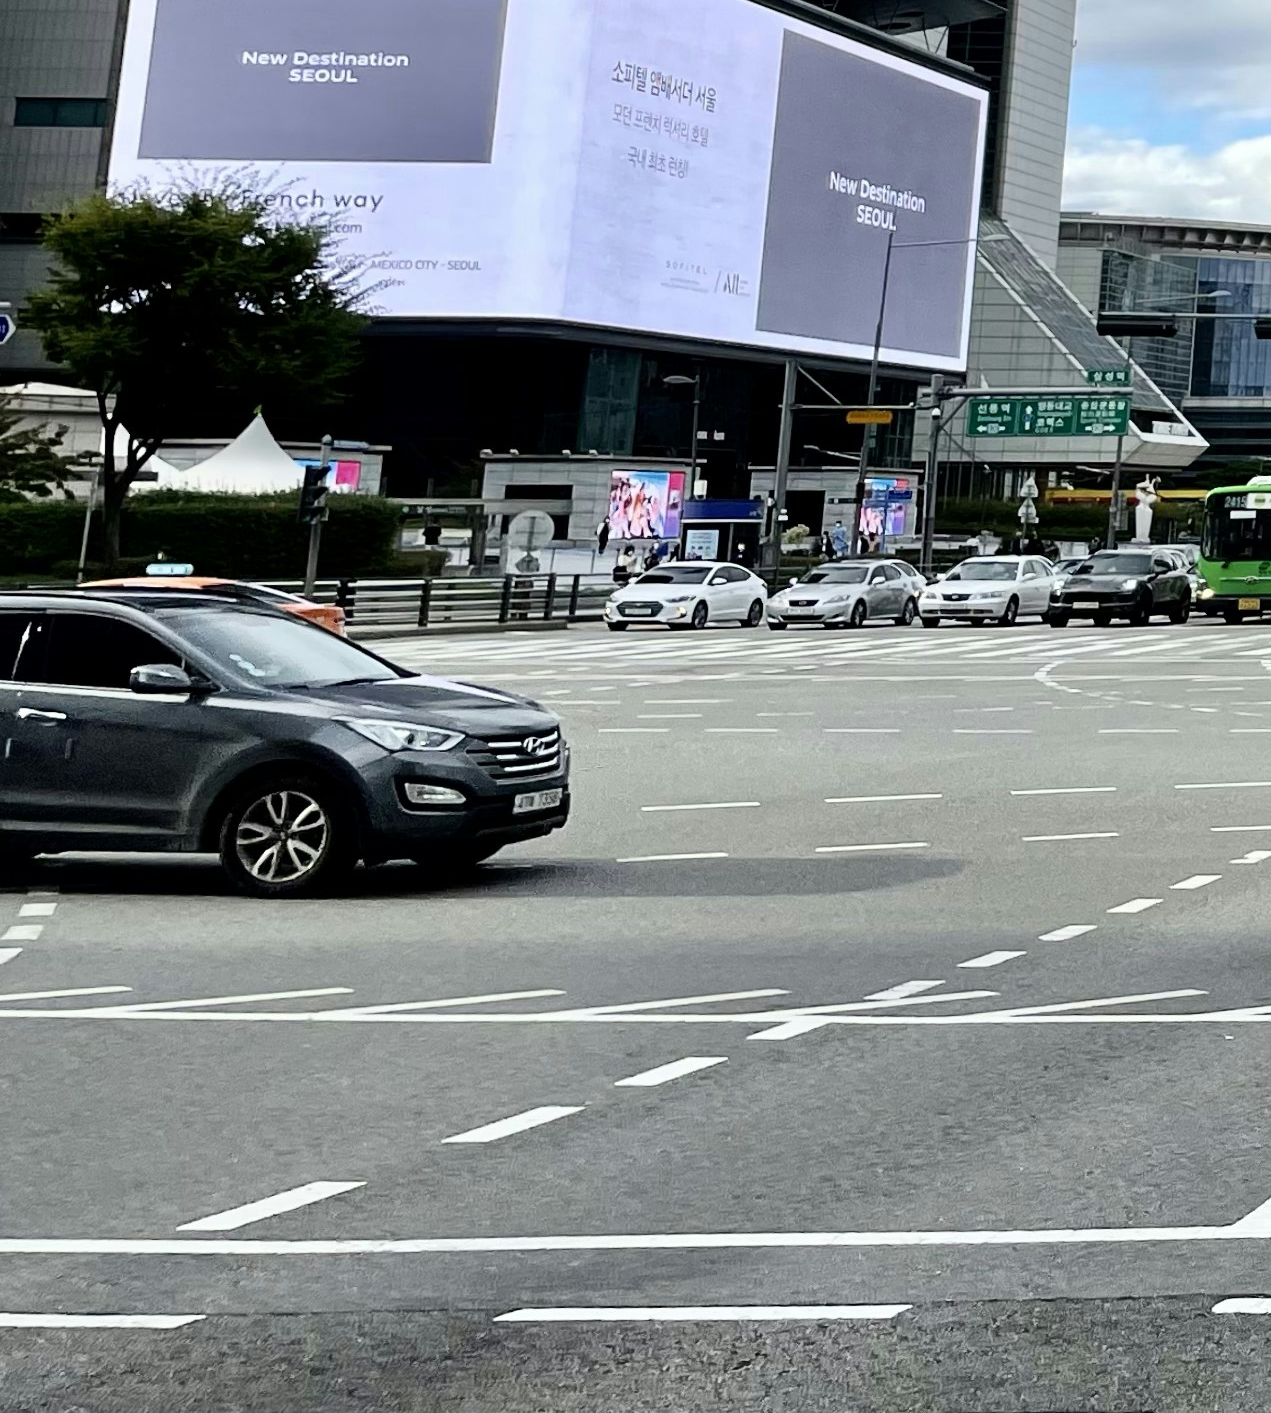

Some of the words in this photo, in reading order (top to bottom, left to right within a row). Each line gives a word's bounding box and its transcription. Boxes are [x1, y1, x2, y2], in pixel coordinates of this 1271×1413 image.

[242, 51, 288, 65] New
[293, 51, 409, 67] Destination
[288, 68, 358, 83] SEOUL
[611, 60, 648, 93] 소피텔
[695, 86, 717, 113] 서울
[612, 103, 632, 127] 모던
[628, 146, 647, 169] 국내
[829, 170, 858, 196] New
[860, 179, 926, 213] Destination
[334, 193, 384, 212] way
[857, 204, 897, 231] SEOUL
[415, 260, 441, 271] CITY
[448, 260, 482, 271] SEOUL
[665, 260, 707, 275] SOFITEL
